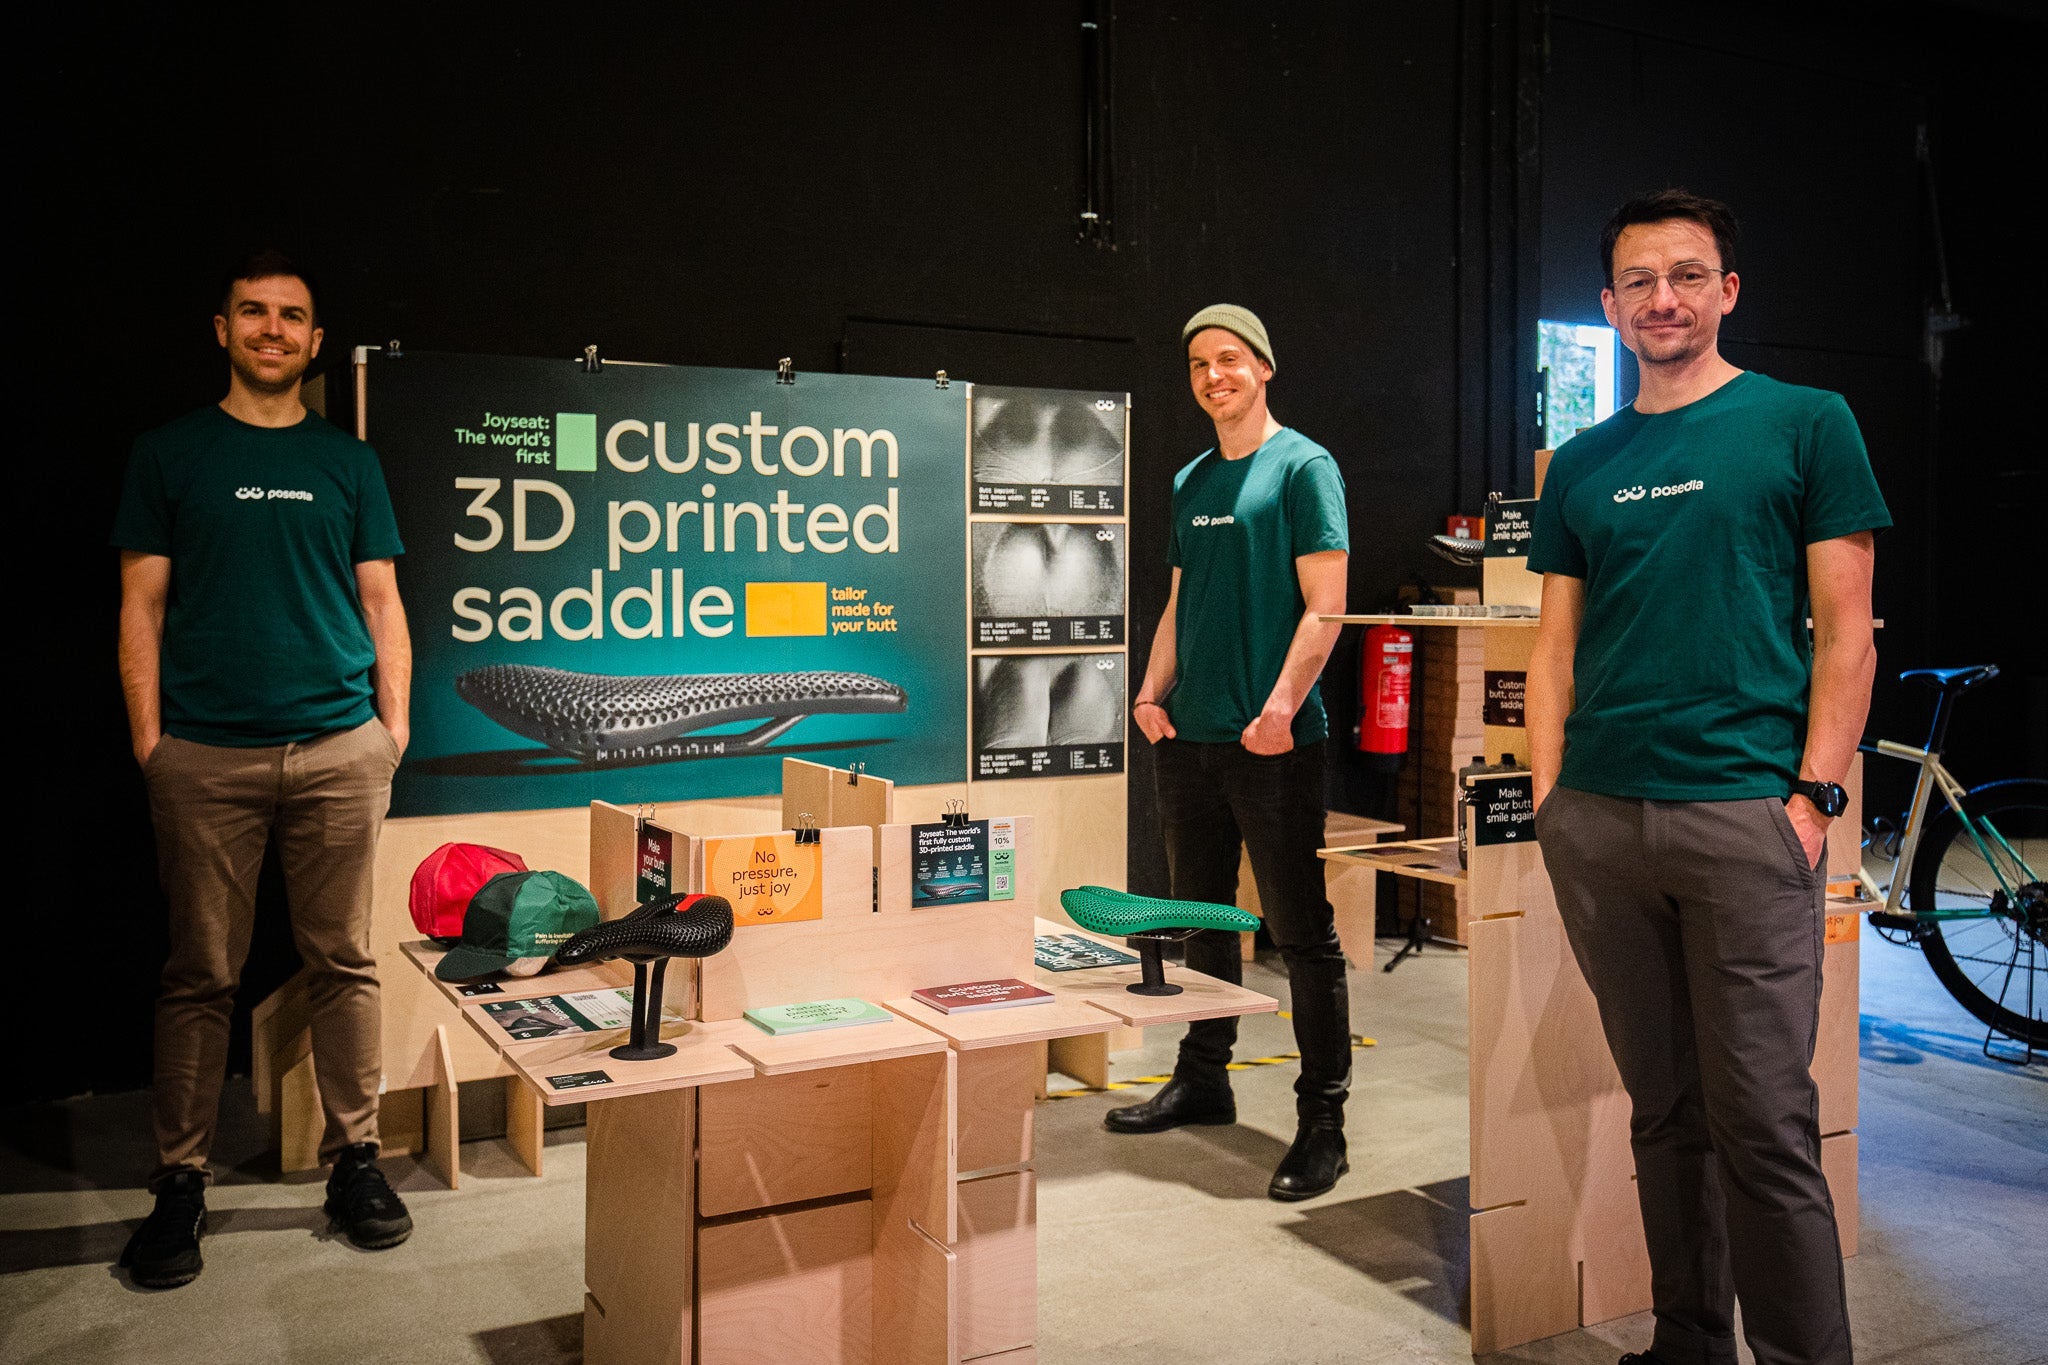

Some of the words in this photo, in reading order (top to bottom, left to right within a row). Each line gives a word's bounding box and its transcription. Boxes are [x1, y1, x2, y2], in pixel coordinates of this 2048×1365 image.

[482, 412, 550, 431] Joyseat:
[454, 428, 486, 444] The
[490, 431, 551, 447] world's
[604, 411, 899, 478] custom
[515, 448, 551, 464] first
[267, 489, 314, 502] posedia
[1651, 479, 1704, 499] posedia
[1502, 510, 1522, 520] Make
[453, 477, 576, 552] 3D
[607, 482, 899, 571] printed
[1495, 522, 1511, 533] your
[1512, 520, 1529, 530] butt
[1492, 530, 1511, 541] smile
[1511, 529, 1532, 542] again
[831, 586, 868, 601] tailor
[451, 568, 734, 642] saddle
[831, 602, 871, 617] made
[872, 601, 895, 616] for
[831, 621, 864, 636] your
[866, 618, 898, 632] butt
[1497, 679, 1526, 690] Custom
[1489, 689, 1507, 700] butt,
[1508, 691, 1525, 700] cust
[1500, 700, 1523, 710] saddle
[1498, 788, 1523, 799] Make
[1489, 801, 1510, 814] your
[1511, 800, 1532, 810] butt
[1486, 812, 1509, 824] smile
[1511, 810, 1535, 824] again
[918, 830, 944, 839] Joyseat:
[958, 827, 981, 835] world's
[648, 838, 660, 855] Make
[918, 838, 932, 846] first
[933, 837, 947, 846] fully
[947, 836, 971, 844] custom
[994, 837, 1010, 845] 10%
[918, 844, 954, 855] 3D-printed
[954, 843, 975, 851] saddle
[755, 850, 776, 864] No
[732, 867, 798, 885] pressure,
[738, 882, 766, 900] just
[769, 881, 791, 897] joy
[948, 983, 1001, 993] Custom
[975, 985, 1025, 994] custom
